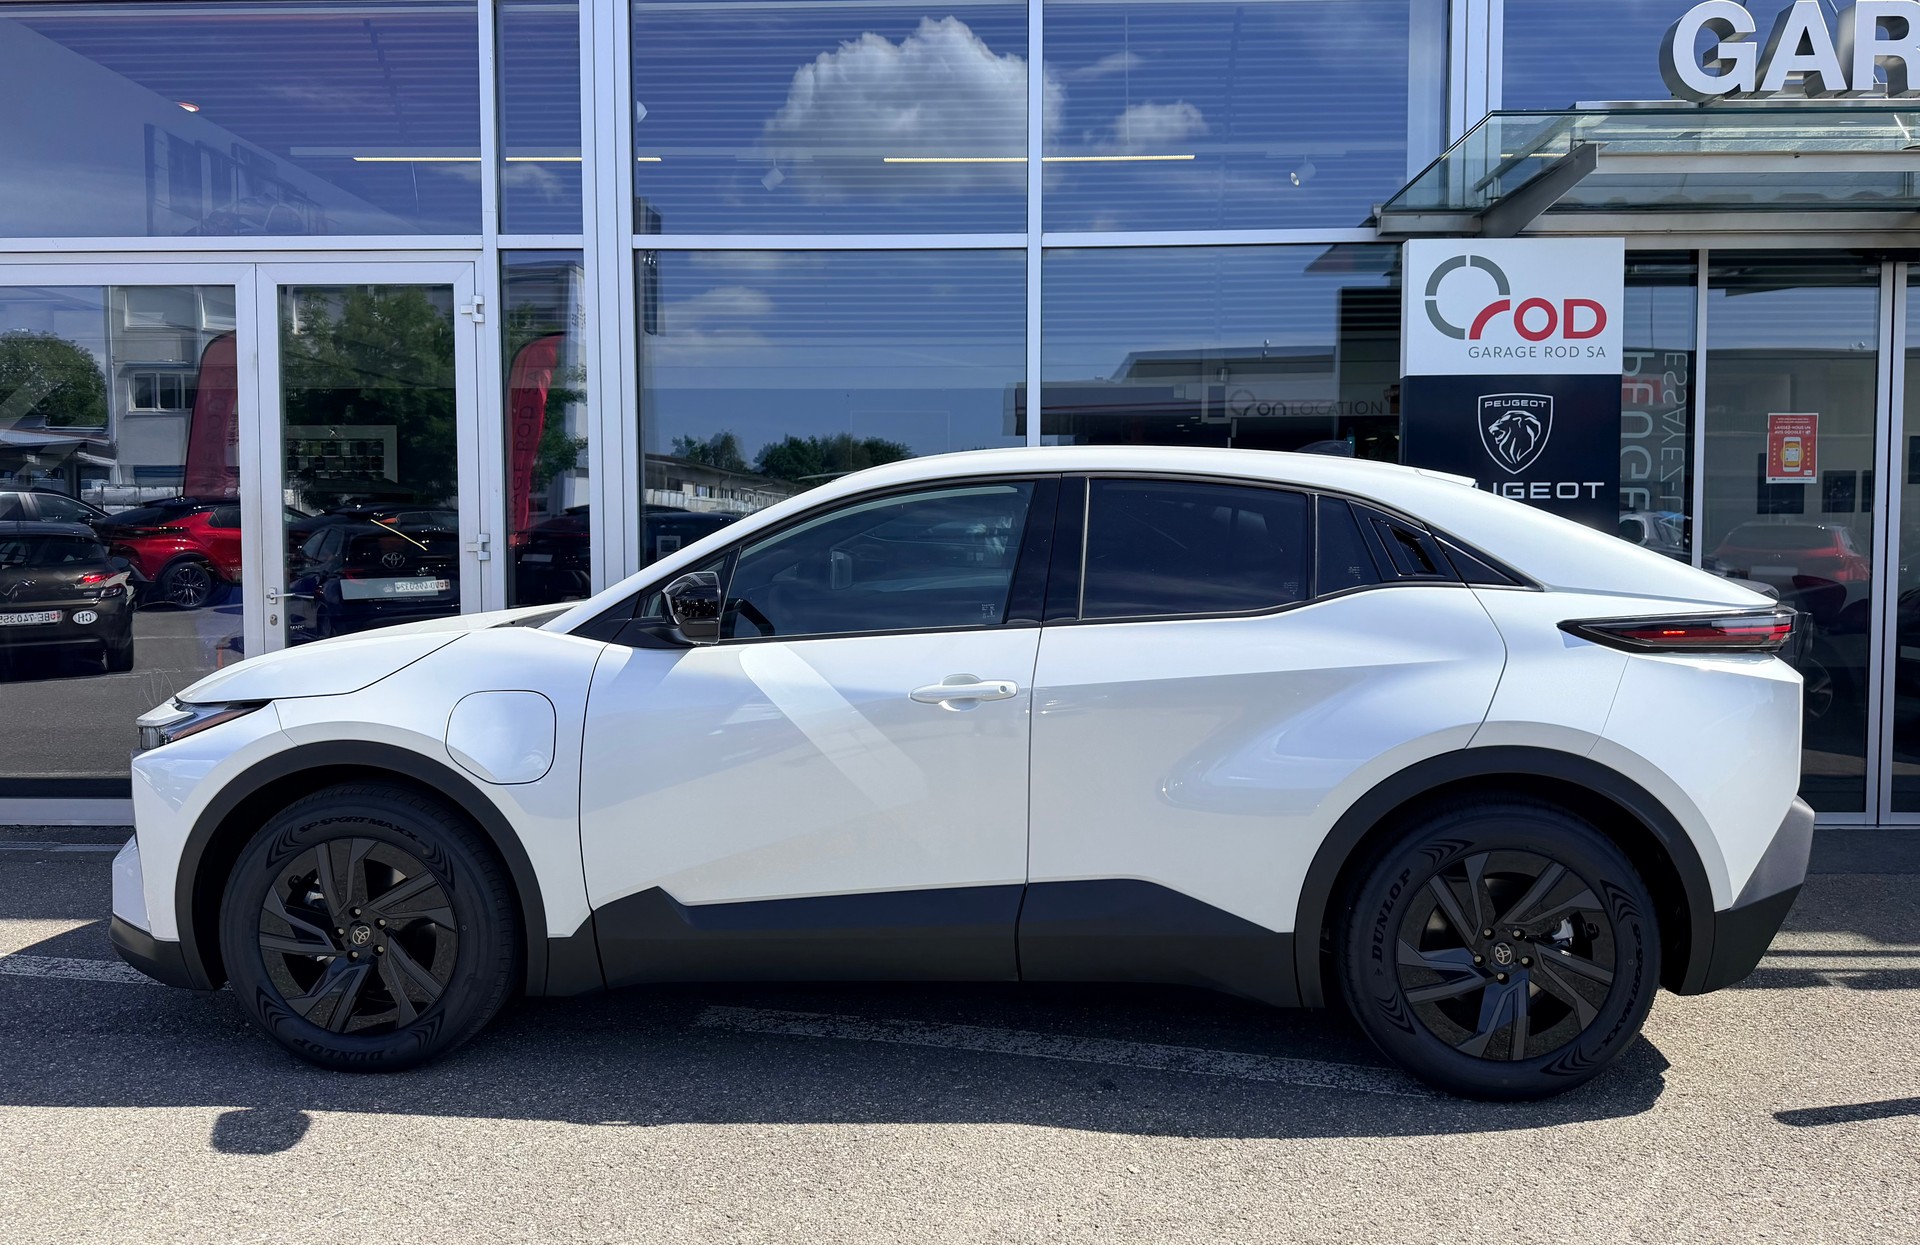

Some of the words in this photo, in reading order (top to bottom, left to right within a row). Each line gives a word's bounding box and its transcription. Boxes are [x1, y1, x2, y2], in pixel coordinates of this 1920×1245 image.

[1671, 0, 1920, 95] GAR
[1468, 346, 1537, 359] GARAGE
[1544, 346, 1580, 359] ROD
[1587, 346, 1606, 359] SA
[1484, 400, 1547, 408] PEUGEOT
[517, 405, 535, 452] ROD
[1474, 482, 1605, 499] GEOT
[319, 816, 368, 827] SPORT
[368, 818, 418, 842] MAXX
[1371, 867, 1413, 963] DUNLOP
[292, 1038, 385, 1062] DUNLOP
